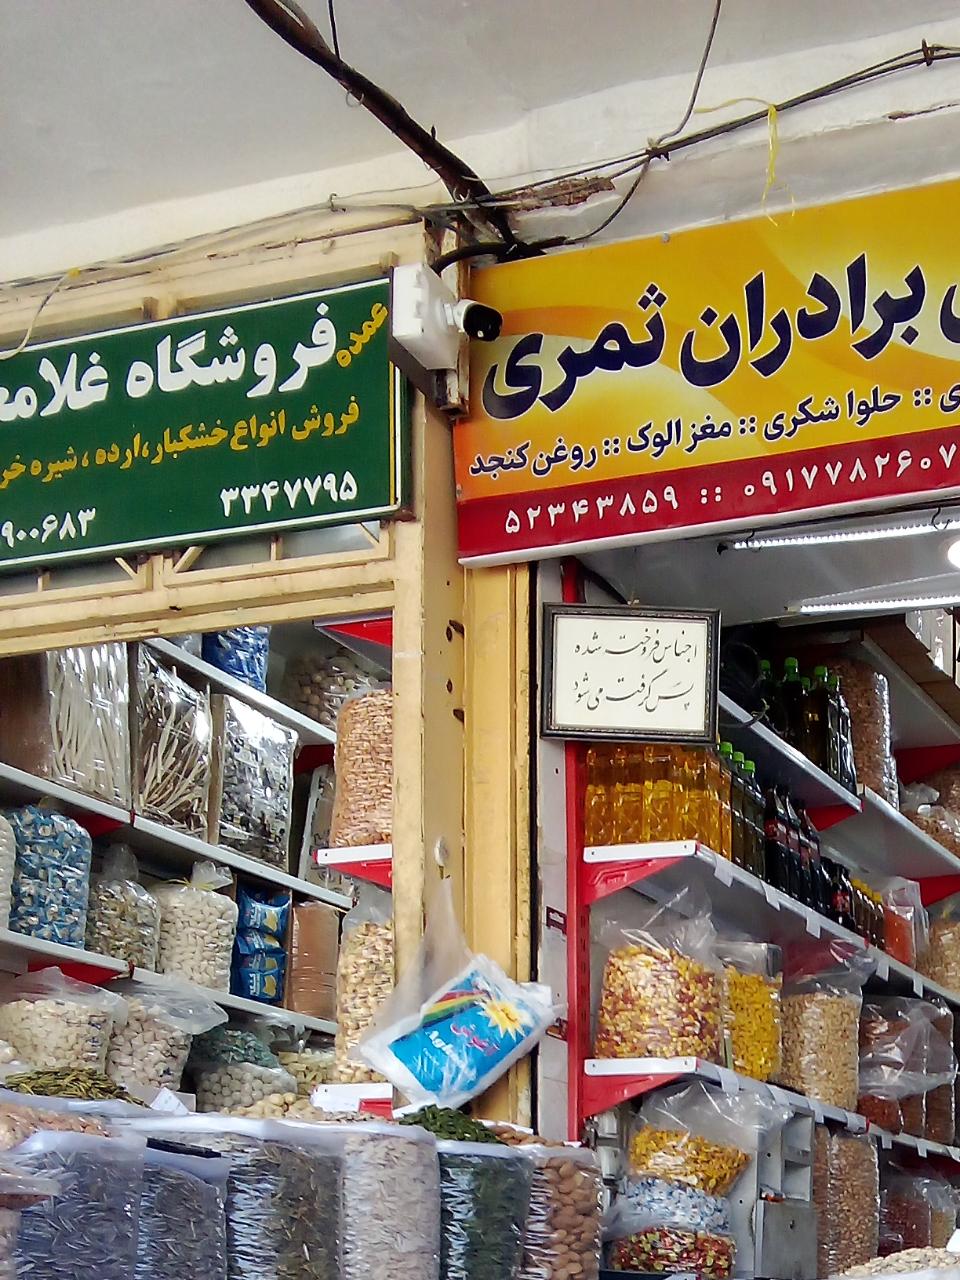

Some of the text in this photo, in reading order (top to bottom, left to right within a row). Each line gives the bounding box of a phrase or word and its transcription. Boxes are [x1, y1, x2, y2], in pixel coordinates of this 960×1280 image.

[336, 302, 388, 367] عمده
[679, 252, 926, 388] برادران
[126, 302, 338, 398] فروشگاه
[481, 282, 667, 420] ثمری
[292, 396, 360, 440] فروش
[763, 396, 840, 440] شکری
[846, 386, 902, 427] حلوا
[230, 409, 286, 451] انواع
[627, 417, 684, 457] الوک
[687, 419, 732, 453] مغز
[30, 446, 77, 483] شیره
[468, 442, 529, 479] کنجد
[532, 437, 597, 476] روغن
[574, 631, 602, 655] شده
